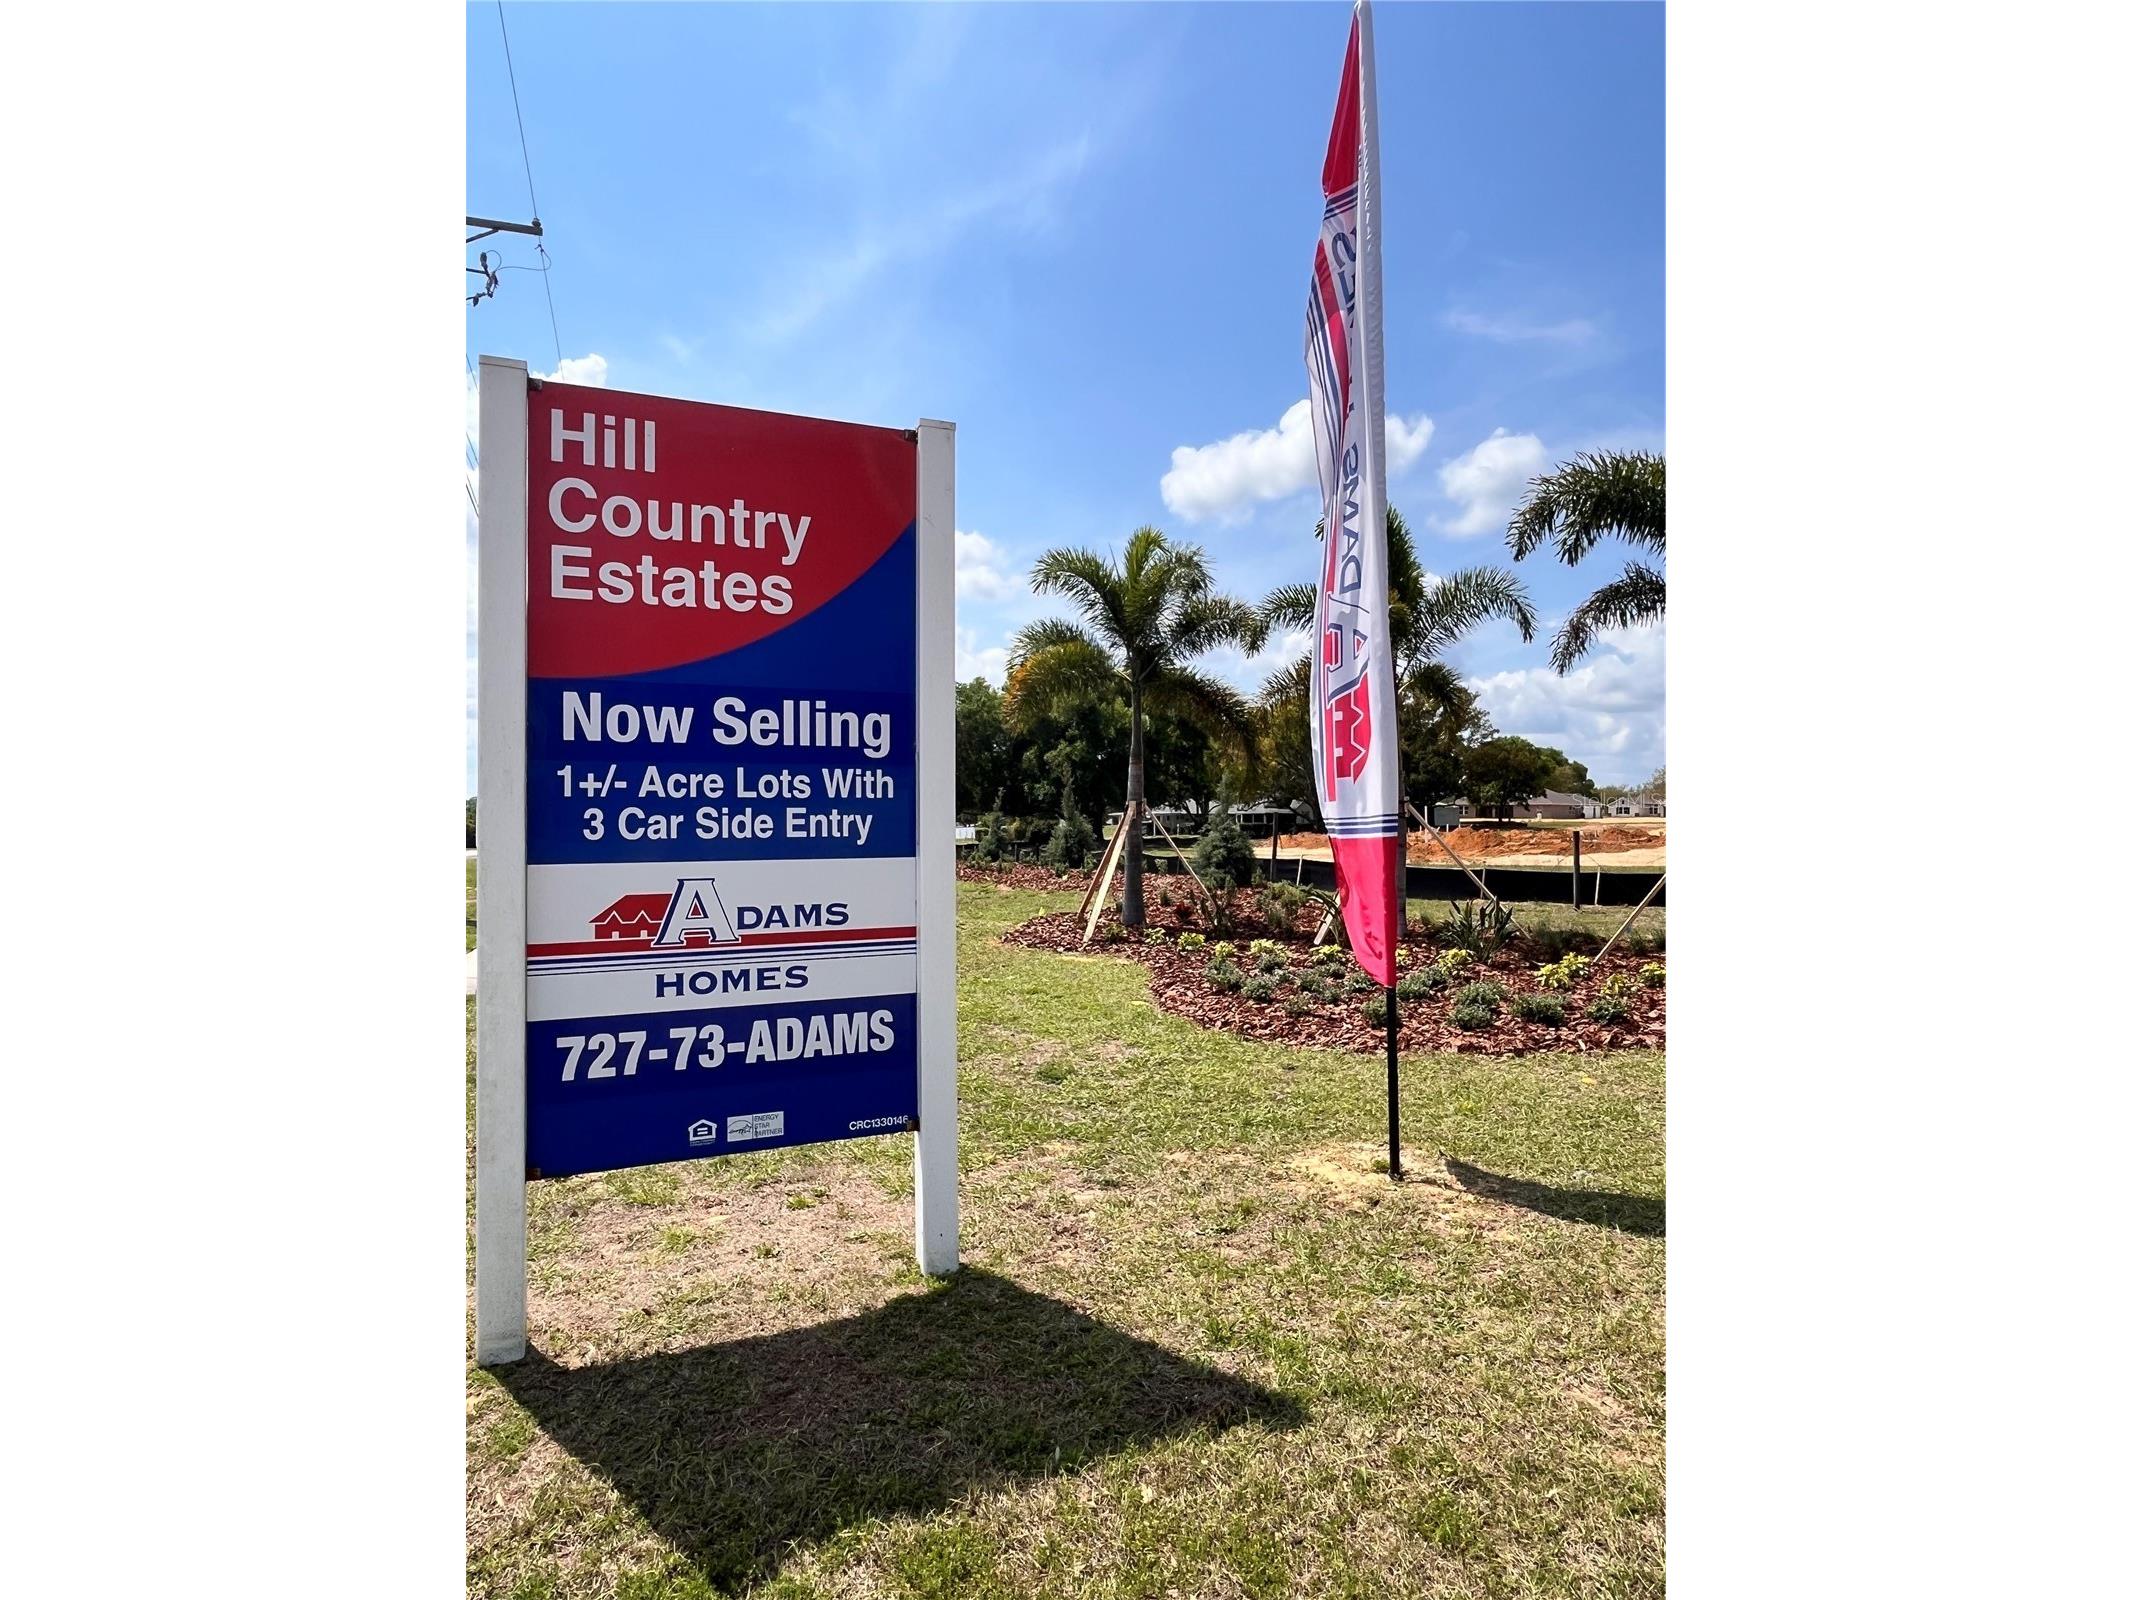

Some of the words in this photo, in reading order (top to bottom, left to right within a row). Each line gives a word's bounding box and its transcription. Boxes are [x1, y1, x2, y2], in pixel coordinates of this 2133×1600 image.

[550, 408, 656, 473] Hill
[548, 477, 811, 565] Country
[550, 544, 794, 615] Estates
[562, 691, 695, 743] Now
[712, 696, 891, 759] Selling
[557, 764, 627, 798] 1+/-
[638, 765, 724, 799] Acre
[736, 766, 811, 799] Lots
[822, 767, 894, 799] With
[582, 807, 605, 841] 3
[618, 806, 684, 840] Car
[695, 806, 774, 840] Side
[785, 806, 873, 846] Entry
[650, 877, 850, 948] ADAMS
[655, 964, 809, 998] HOMES
[556, 1009, 895, 1082] 727-73-ADAMS
[754, 1113, 779, 1122] ENERGY
